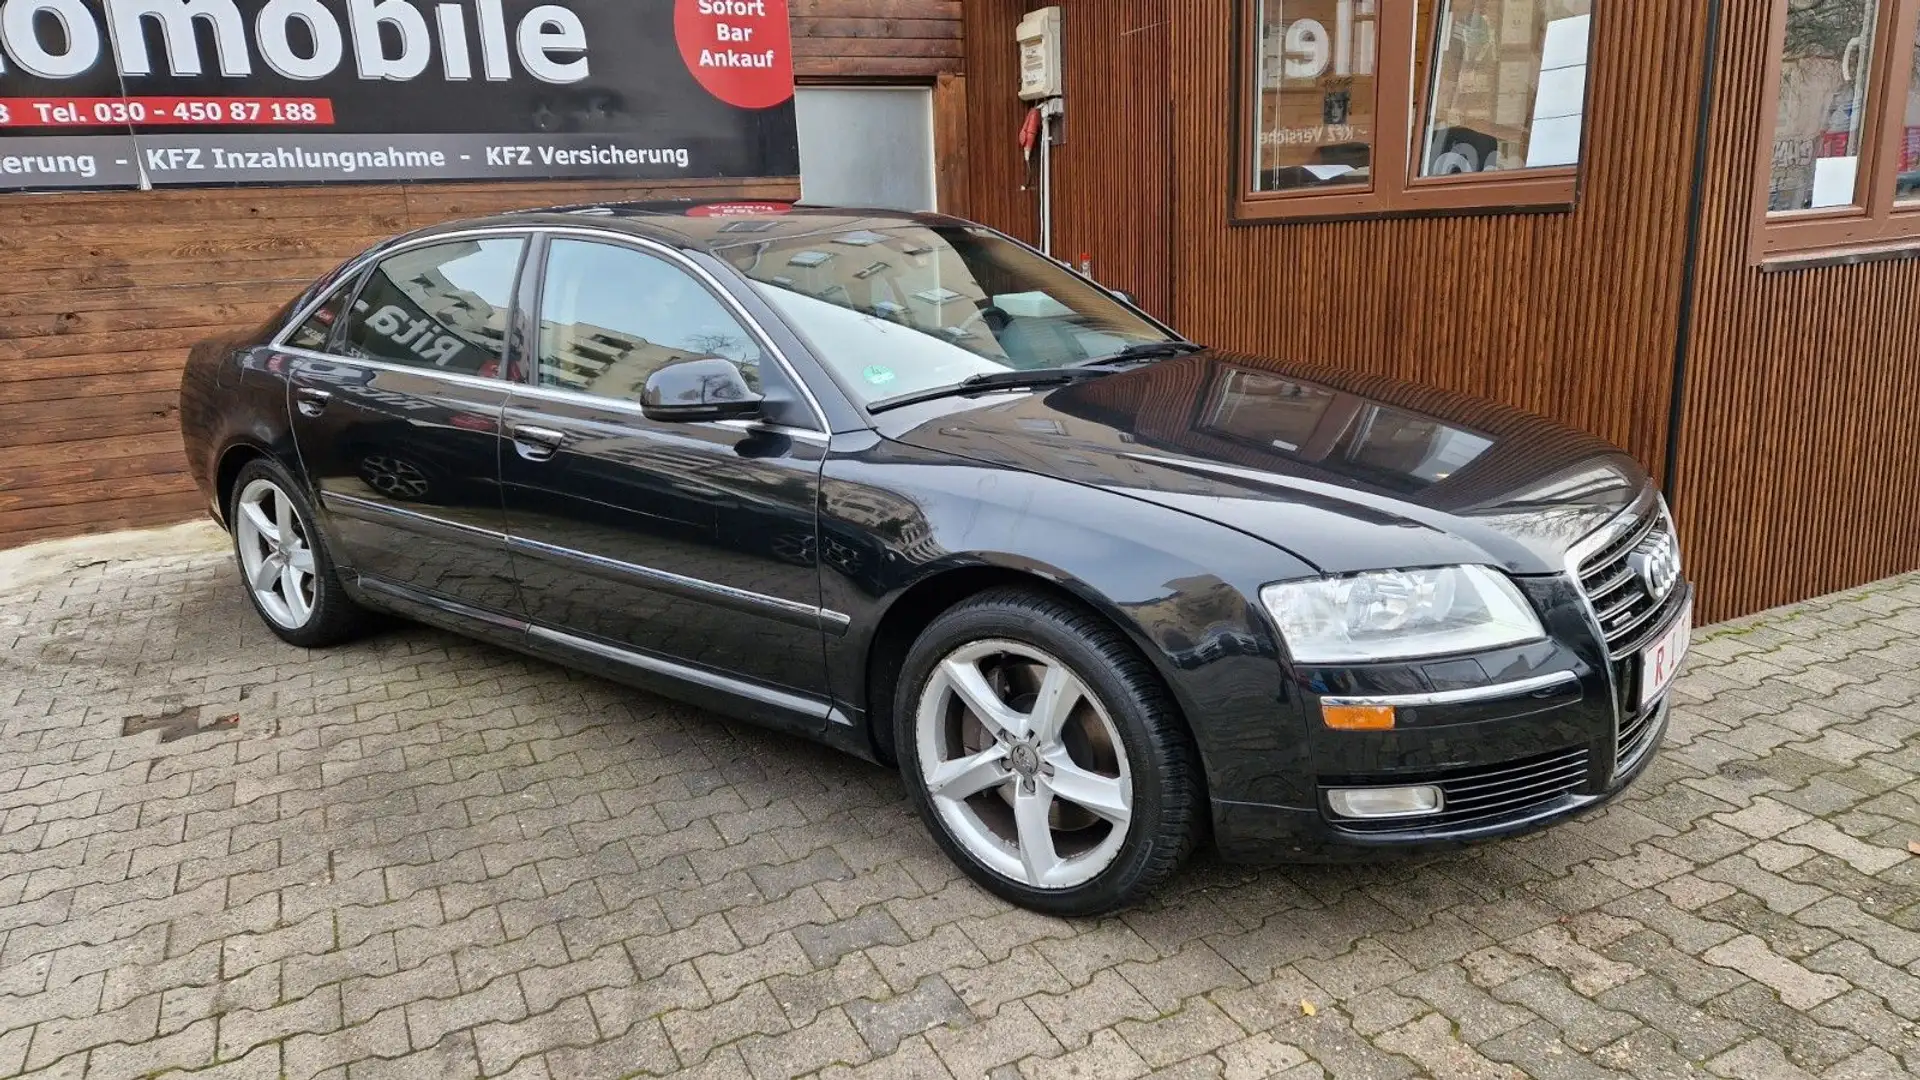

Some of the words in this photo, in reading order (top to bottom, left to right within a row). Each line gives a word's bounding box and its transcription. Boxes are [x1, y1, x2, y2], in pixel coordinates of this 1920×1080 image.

[698, 0, 766, 16] Sofort
[0, 0, 590, 84] omobile
[716, 22, 753, 42] Bar
[699, 49, 774, 67] Ankauf
[33, 103, 87, 123] Tel.
[94, 102, 145, 122] 030
[173, 102, 222, 121] 450
[229, 103, 260, 121] 87
[270, 103, 317, 121] 188
[0, 154, 96, 178] erung
[146, 148, 205, 170] KFZ
[212, 146, 445, 173] Inzahlungnahme
[486, 146, 533, 166] KFZ
[538, 145, 689, 168] Versicherung
